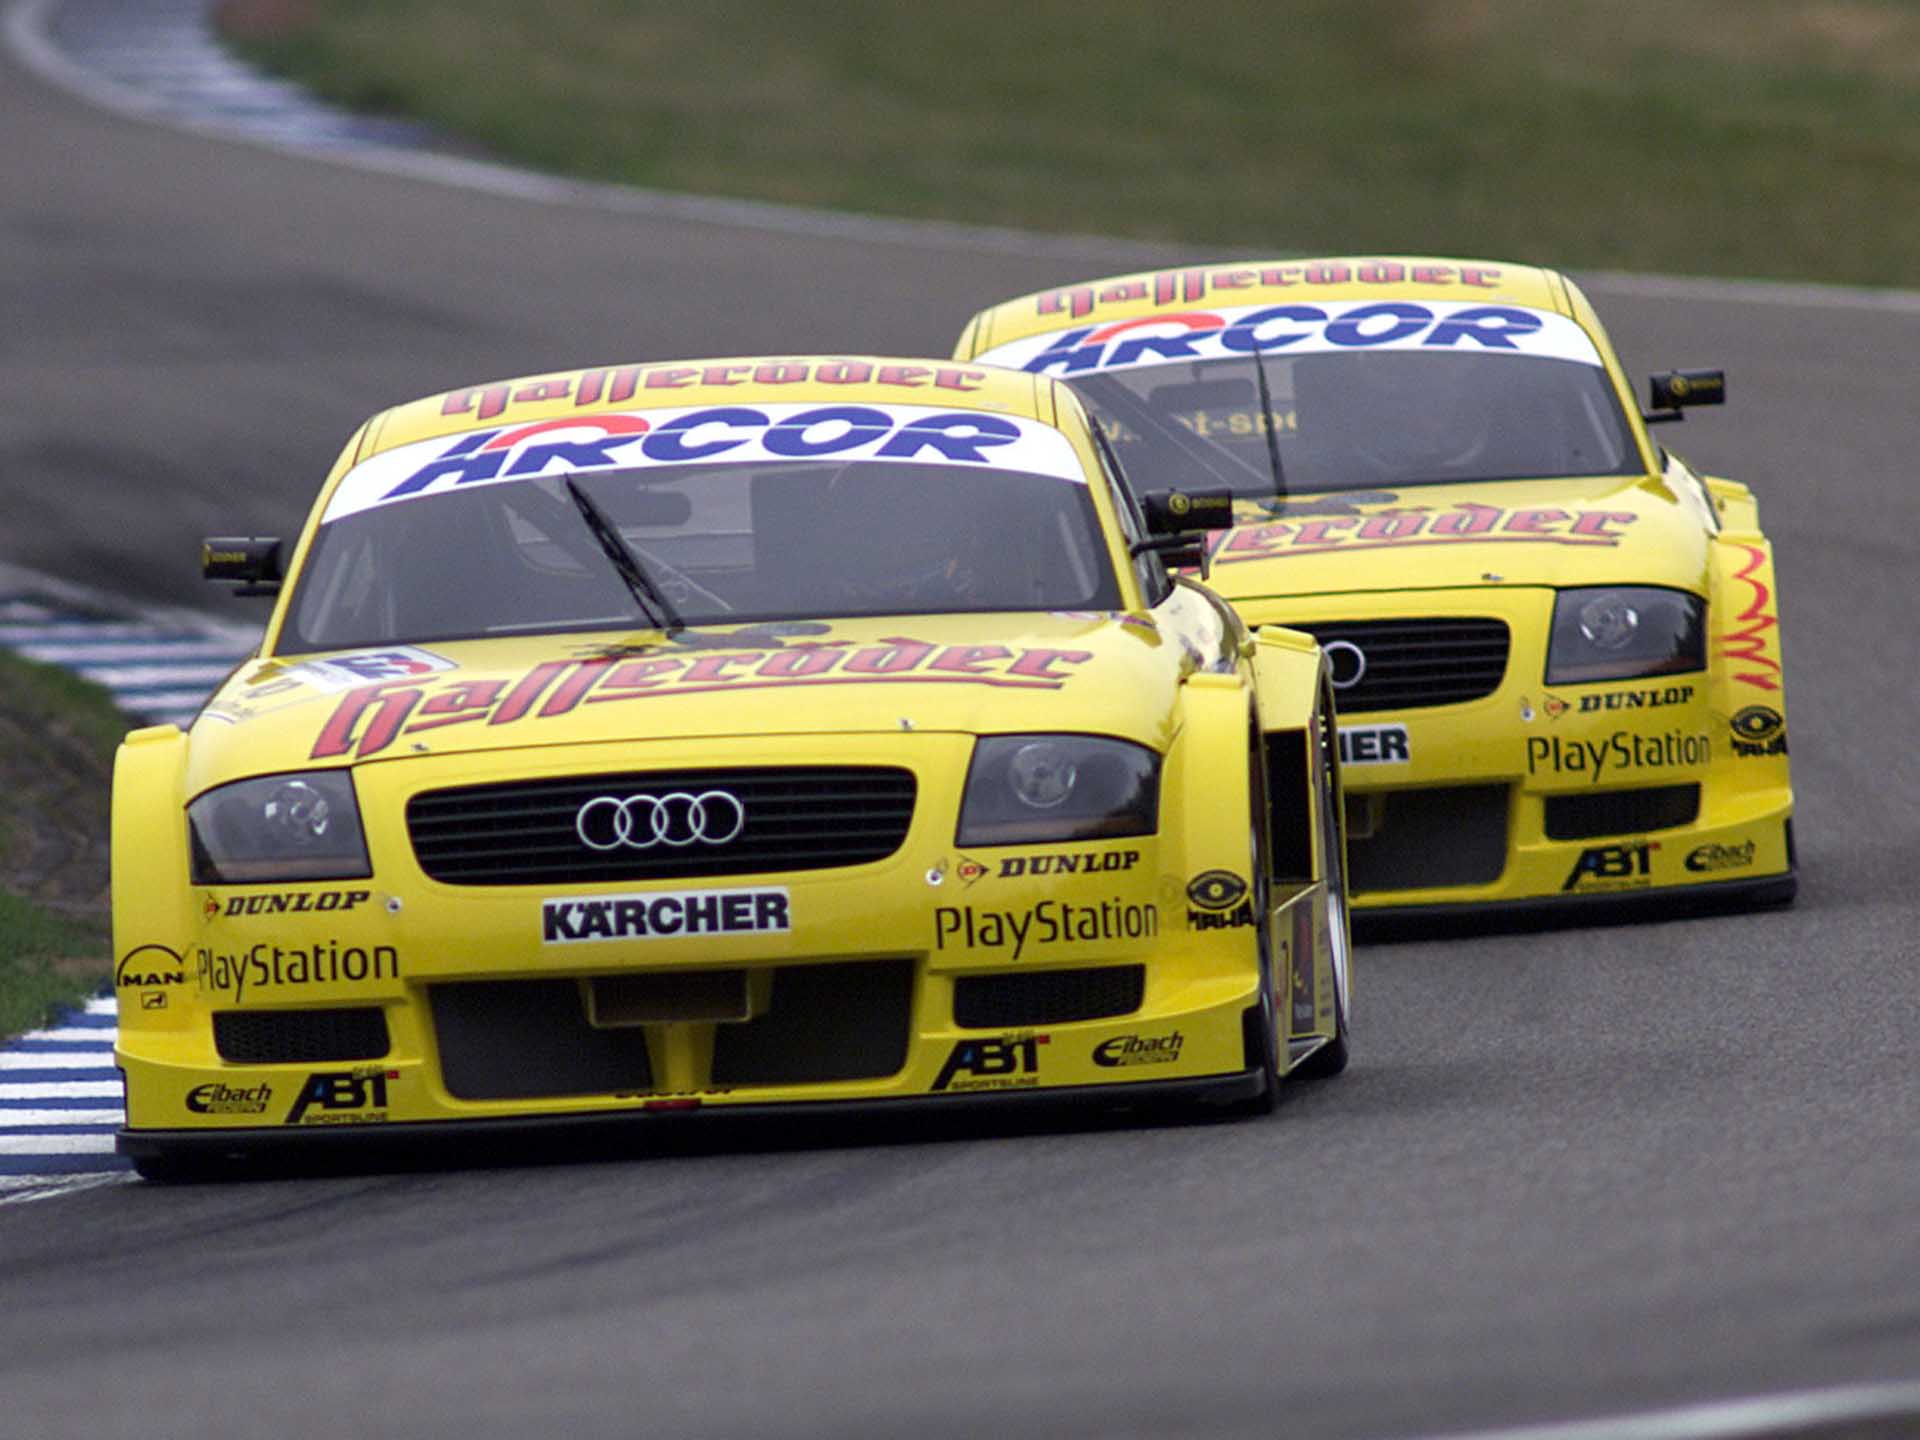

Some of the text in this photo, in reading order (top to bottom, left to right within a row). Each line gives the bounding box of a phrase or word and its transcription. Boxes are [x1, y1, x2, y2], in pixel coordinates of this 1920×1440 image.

[1021, 301, 1543, 374] ARCOR
[379, 406, 1021, 501] ARCOR
[1577, 687, 1695, 713] DUNLOP
[1527, 728, 1711, 784] PlayStation
[998, 850, 1141, 878] DUNLOP
[1562, 844, 1652, 891] ABT
[223, 890, 371, 917] DUNLOP
[543, 892, 790, 942] KÄRCHER
[935, 897, 1158, 961] PlayStation
[122, 971, 185, 987] MAN
[197, 940, 399, 1004] PlayStation
[931, 1035, 1039, 1091] ABT
[1091, 1031, 1185, 1067] Eibach
[185, 1082, 273, 1114] Eibach
[284, 1071, 389, 1124] ABT
